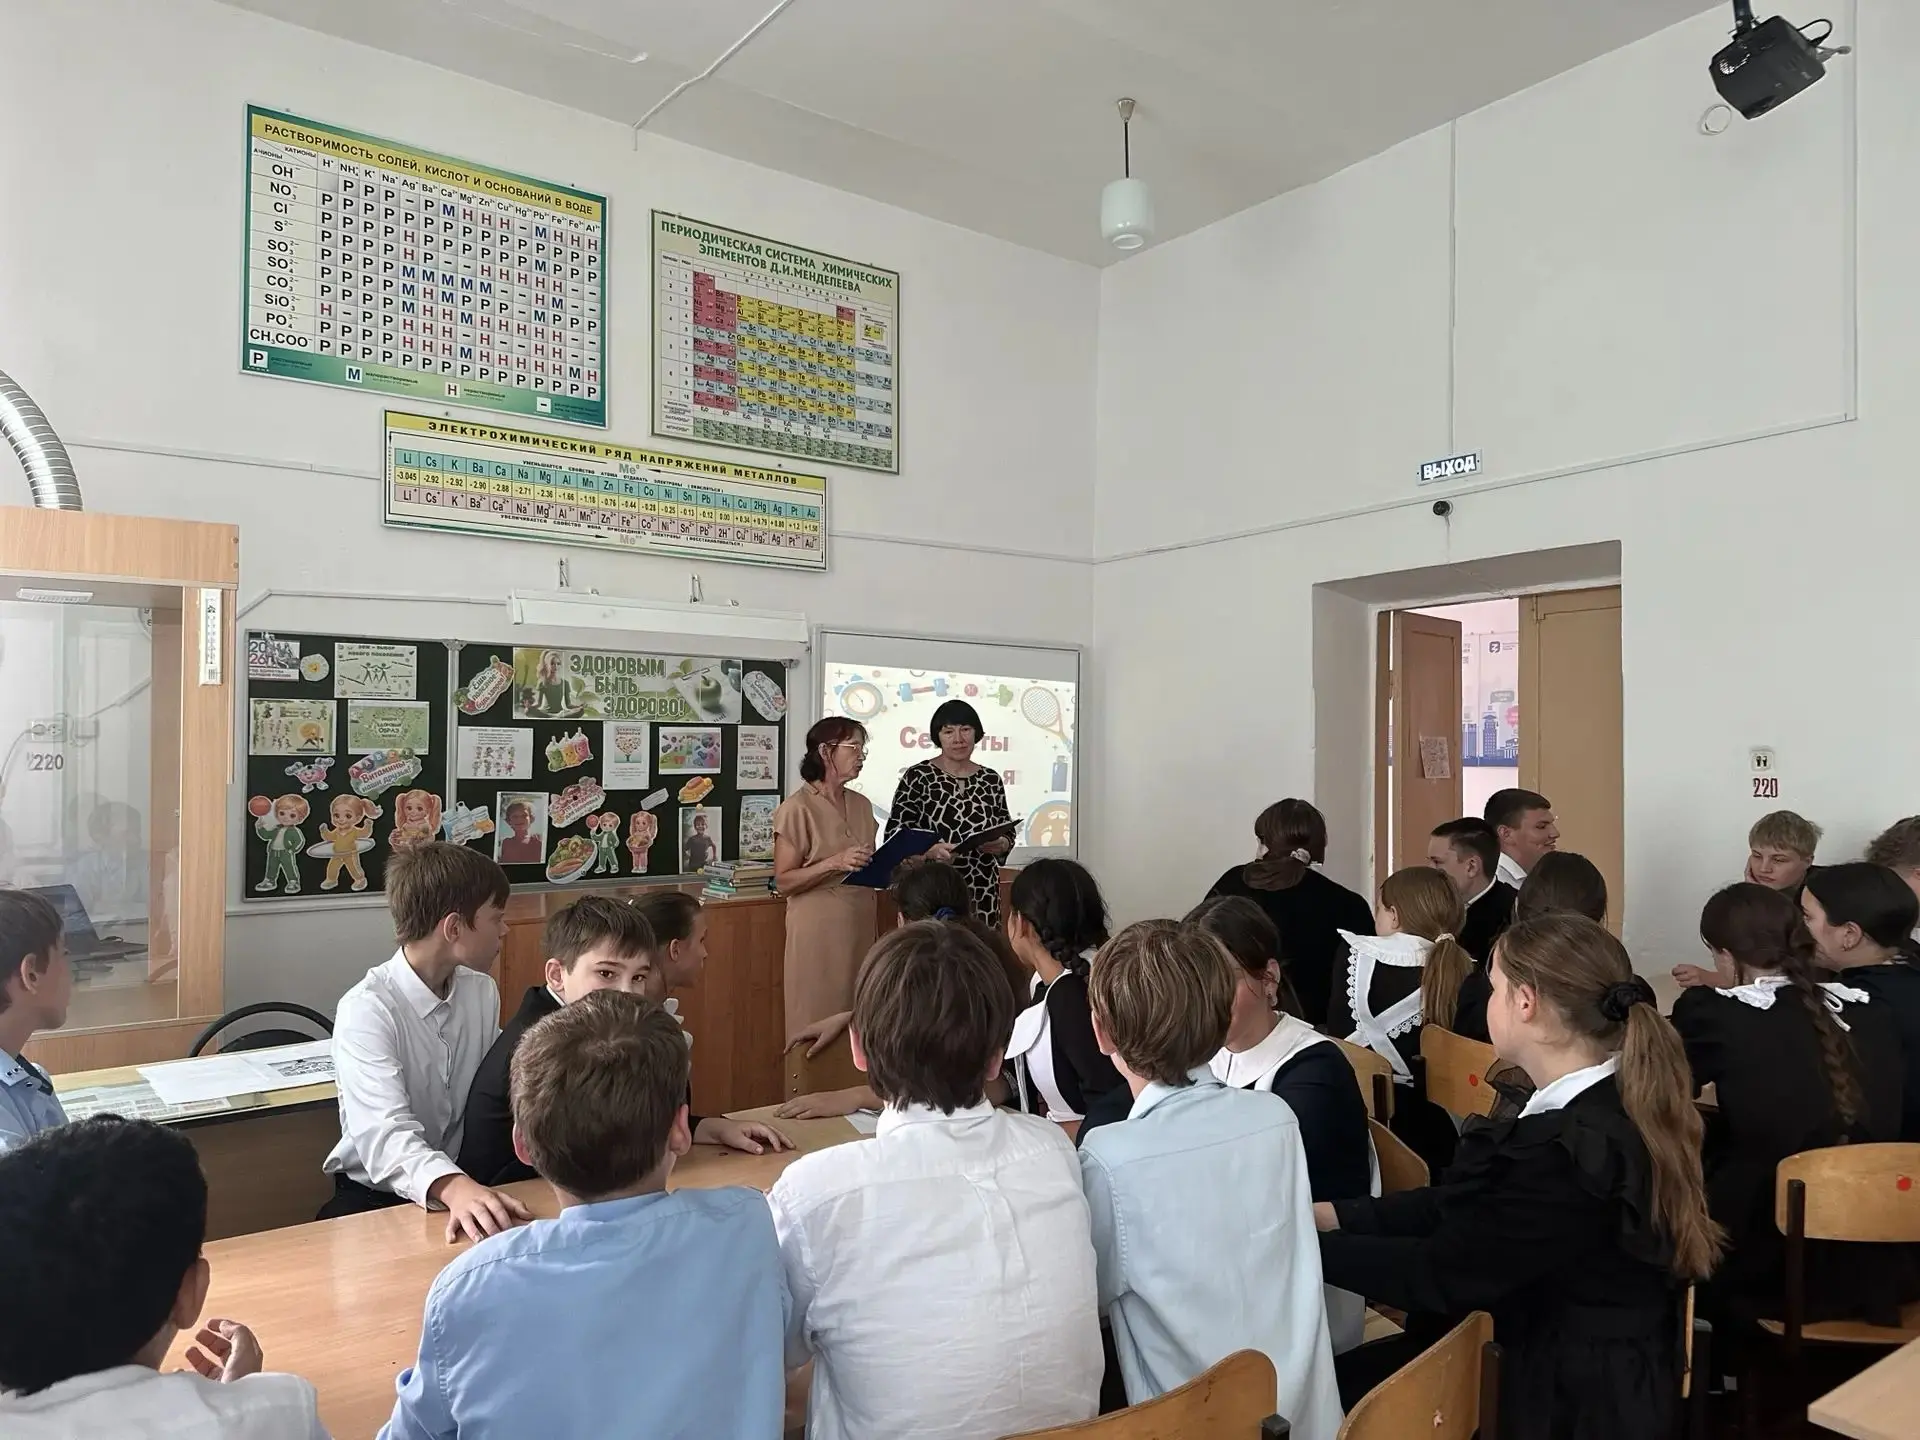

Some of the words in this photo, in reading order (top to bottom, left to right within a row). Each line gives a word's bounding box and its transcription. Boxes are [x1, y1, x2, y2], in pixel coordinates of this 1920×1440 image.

[264, 123, 374, 160] РАСТВОРИМОСТЬ
[377, 153, 421, 173] СОЛЕЙ,
[425, 164, 470, 183] КИСЛОТ
[473, 177, 481, 186] И
[484, 180, 551, 204] ОСНОВАНИЙ
[555, 197, 562, 206] В
[565, 200, 593, 215] ВОДЕ
[661, 220, 762, 255] ПЕРИОДИЧЕСКАЯ
[765, 247, 816, 270] СИСТЕМА
[822, 261, 893, 289] ХИМИЧЕСКИХ
[698, 243, 767, 269] ЭЛЕМЕНТОВ
[428, 421, 597, 455] ЭЛЕКТРОХИМИЧЕСКИЙ
[605, 448, 632, 461] РЯД
[640, 454, 727, 475] НАПРЯЖЕНИЙ
[733, 468, 798, 485] МЕТАЛЛОВ
[1423, 455, 1476, 480] ВЫХОД
[403, 452, 412, 464] Li
[425, 456, 437, 467] Cs
[451, 459, 458, 470] K
[472, 462, 484, 474] Ba
[495, 465, 507, 477] Ca
[517, 469, 529, 480] Na
[539, 470, 552, 484] Mg
[562, 474, 571, 485] Al
[582, 477, 594, 489] Mn
[603, 480, 614, 491] Zn
[624, 483, 634, 494] Fe
[643, 485, 654, 497] Co
[664, 488, 673, 499] Ni
[682, 491, 693, 502] Sn
[701, 493, 711, 504] Pb
[737, 499, 747, 510] Cu
[753, 501, 767, 512] 2Hg
[773, 504, 782, 516] Ag
[791, 506, 798, 516] Pt
[806, 507, 816, 518] Au
[570, 654, 666, 677] ЗДОРОВЫМ
[594, 676, 639, 695] БЫТЬ
[603, 697, 685, 718] ЗДОРОВО!
[900, 726, 1009, 752] Сеты
[1752, 777, 1778, 798] 220
